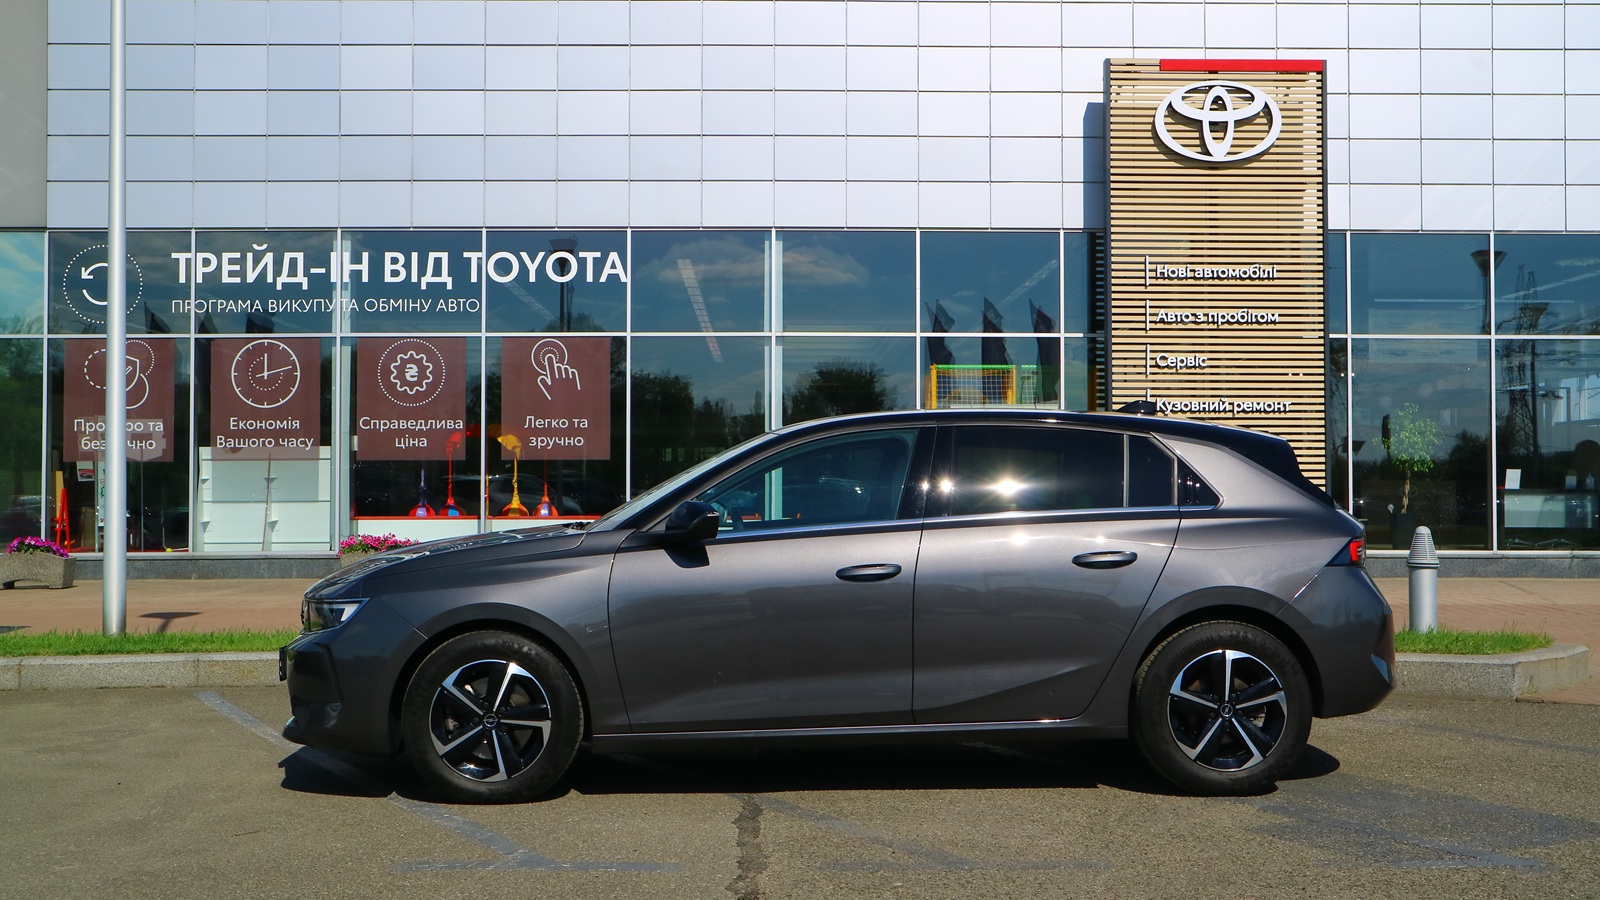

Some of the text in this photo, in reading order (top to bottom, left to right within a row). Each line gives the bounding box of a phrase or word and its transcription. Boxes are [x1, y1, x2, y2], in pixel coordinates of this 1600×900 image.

[171, 243, 628, 291] ТРЕЙД-ІН ВІД TOYOTA
[1155, 264, 1278, 278] Нові автомобілі
[171, 298, 480, 313] ПРОГРАМА ВИКУПУ ТА ОБМІНУ АВТО
[1156, 309, 1279, 326] Авто з пробігом
[1156, 354, 1208, 370] Сервіс
[1156, 397, 1292, 415] Кузовний ремонт
[74, 418, 164, 435] Проро та
[229, 417, 300, 430] Економія
[359, 416, 464, 432] Справедлива
[524, 415, 588, 429] Легко та
[81, 436, 156, 450] безчно
[216, 435, 314, 450] Вашого часу
[395, 434, 428, 448] ціна
[528, 436, 584, 451] зручно
